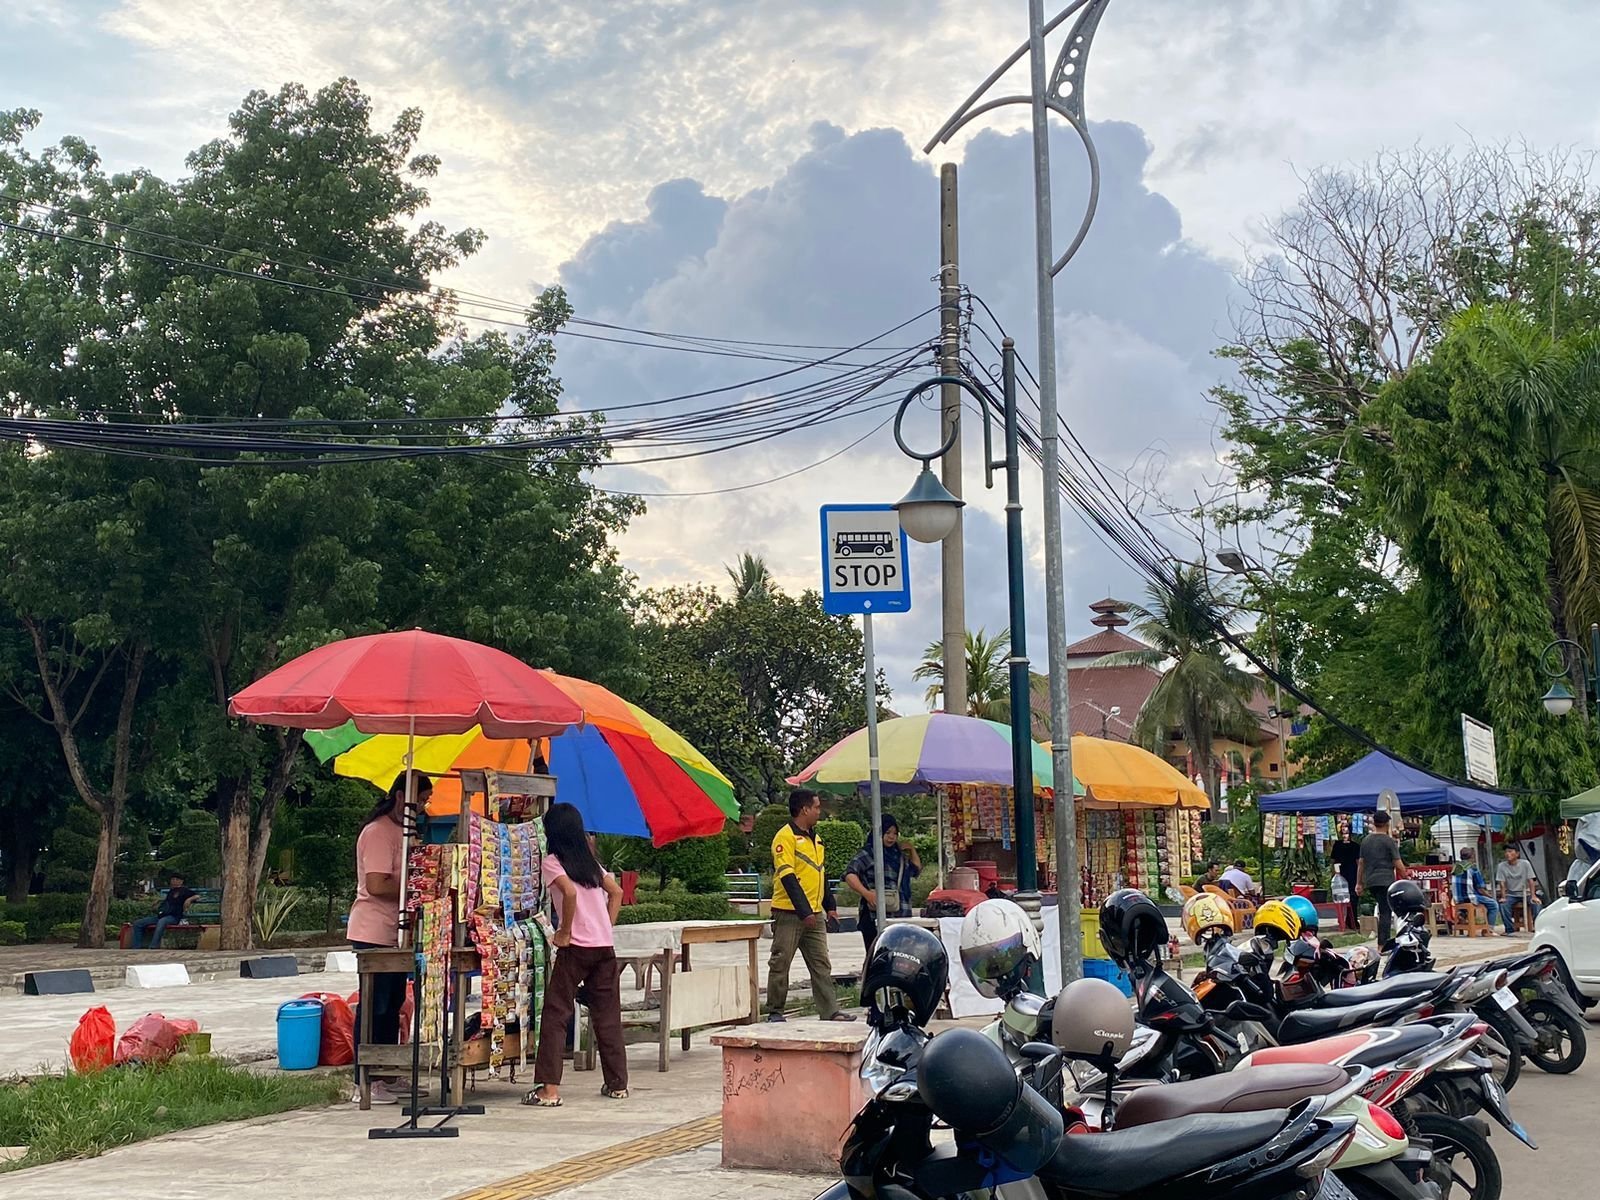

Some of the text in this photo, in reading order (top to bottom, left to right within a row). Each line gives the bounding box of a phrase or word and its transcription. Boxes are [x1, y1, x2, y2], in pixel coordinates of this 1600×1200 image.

[835, 564, 896, 587] STOP
[1411, 869, 1447, 880] Ngodeng
[893, 951, 921, 965] HONDA
[1093, 1029, 1125, 1039] Classic
